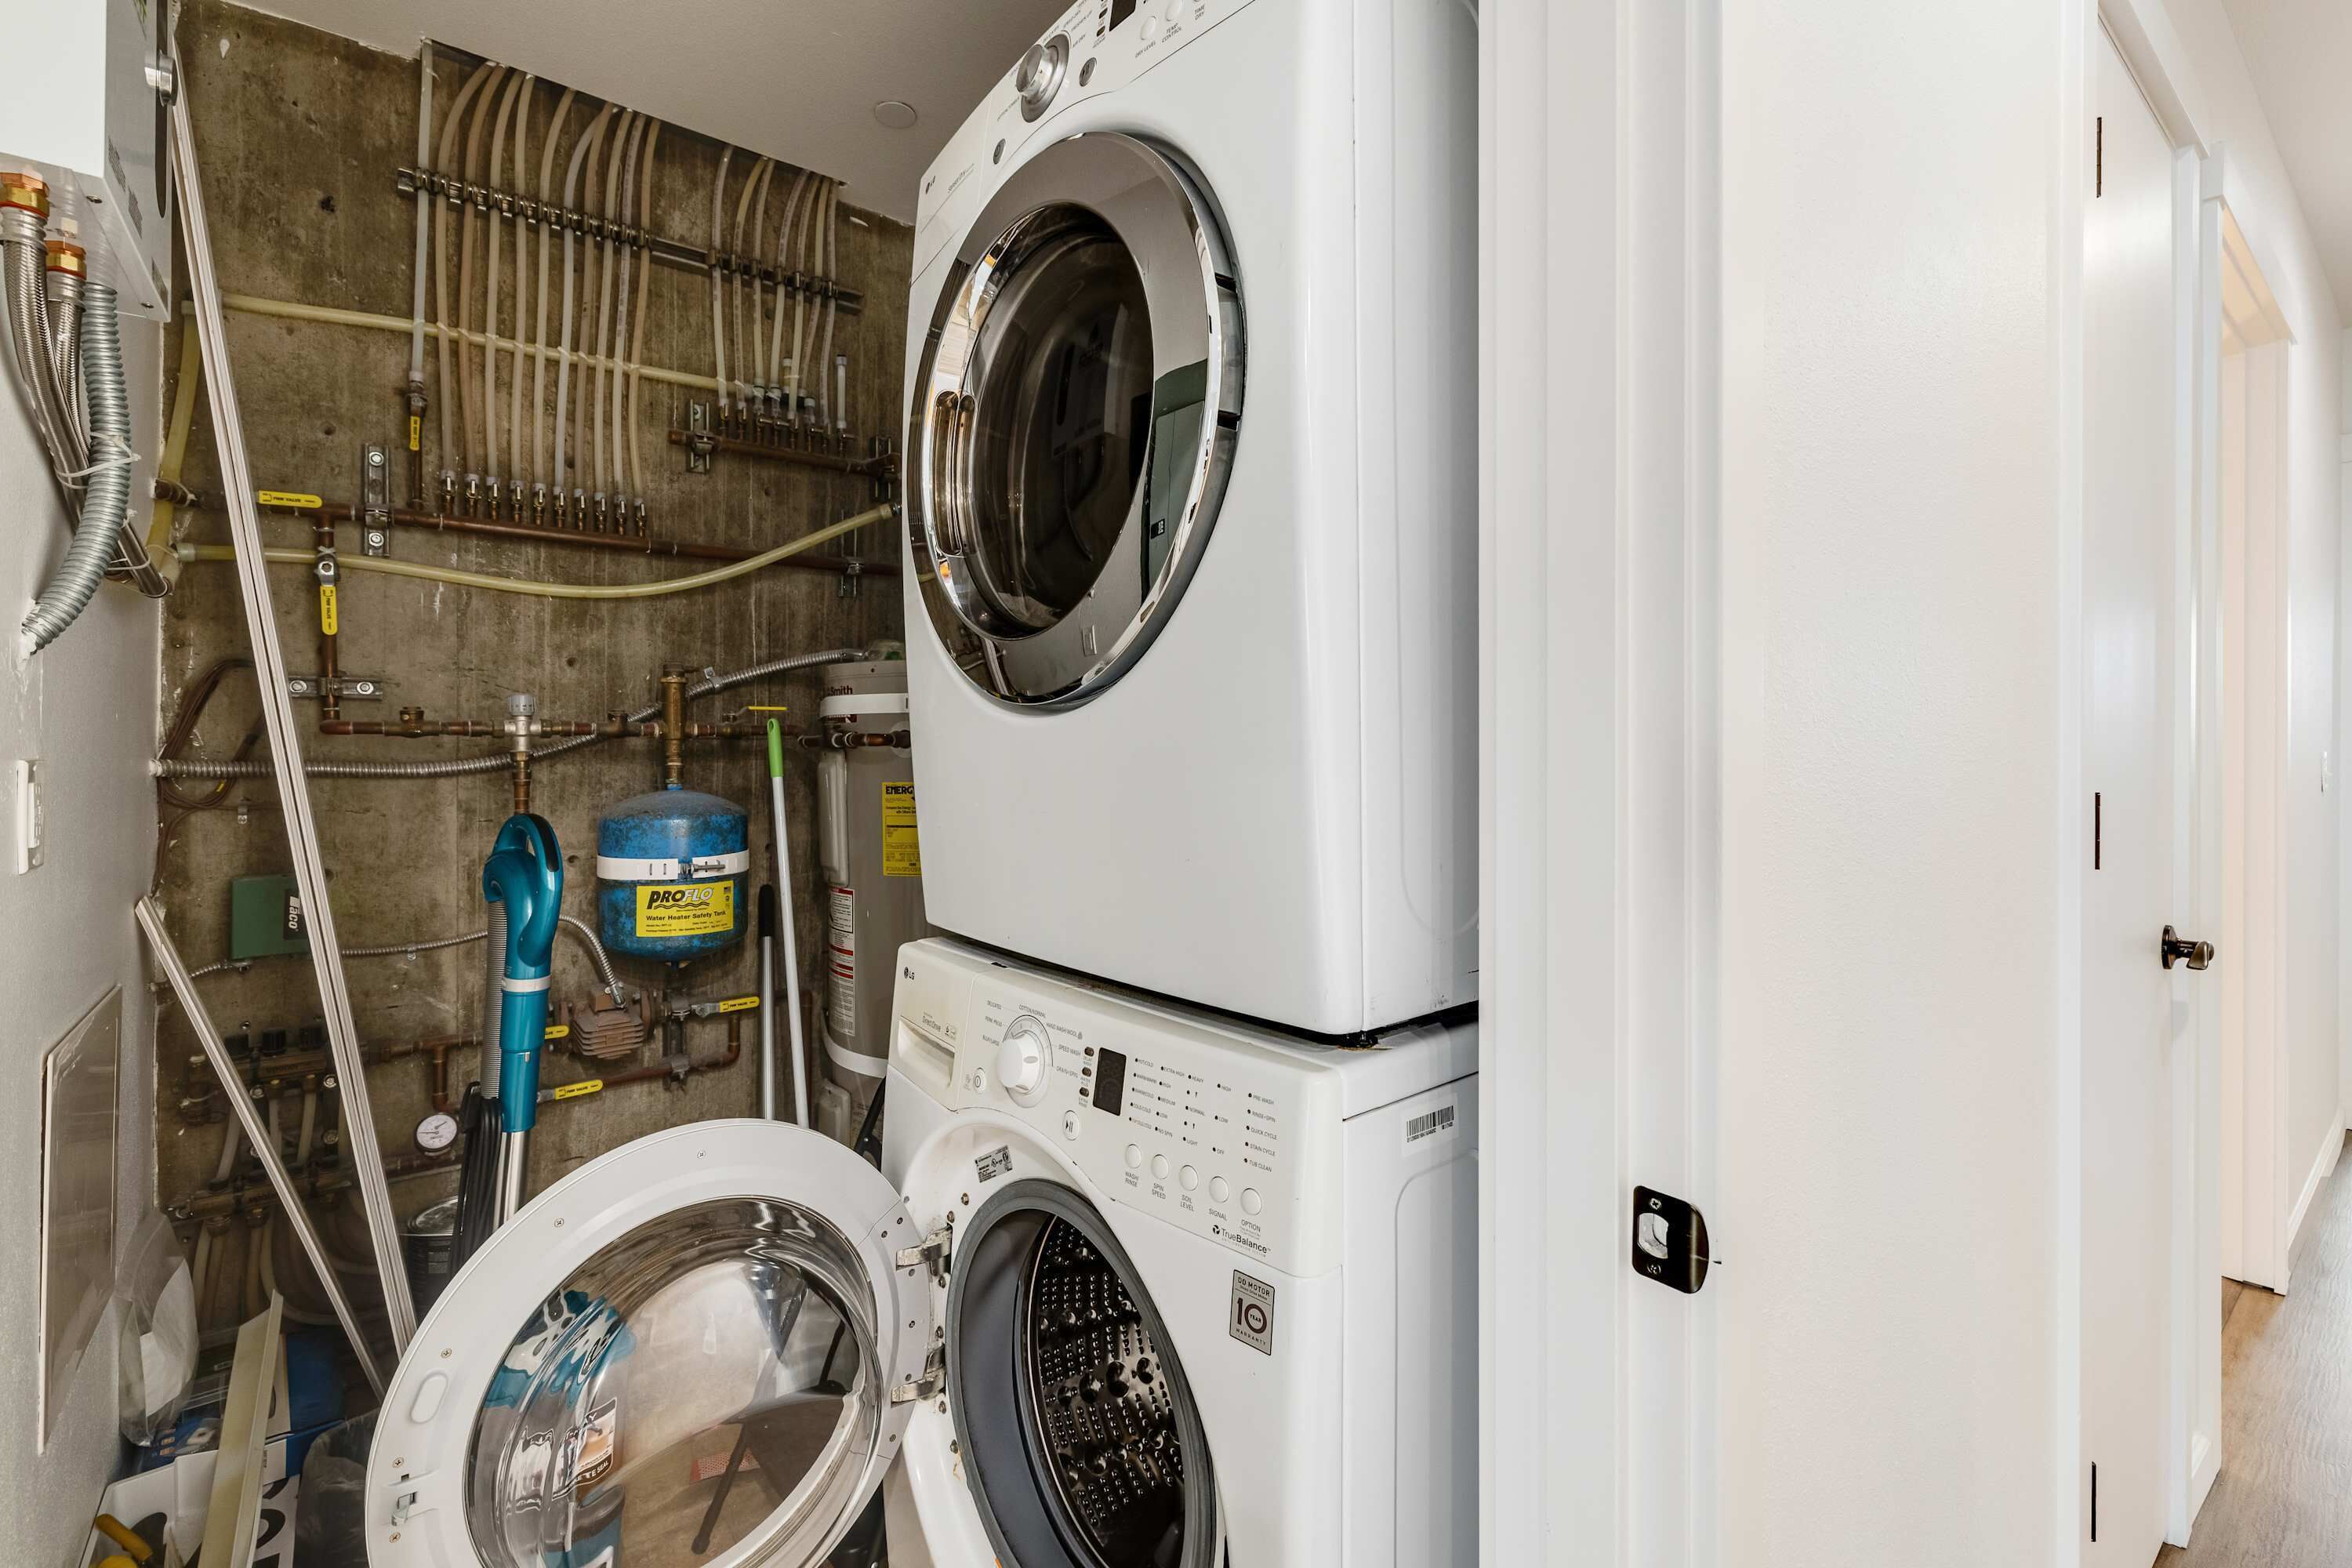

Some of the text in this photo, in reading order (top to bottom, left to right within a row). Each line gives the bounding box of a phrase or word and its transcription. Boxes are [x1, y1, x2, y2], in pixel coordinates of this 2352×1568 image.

[1144, 40, 1156, 53] LEVEL
[647, 887, 714, 909] PROFLO
[1250, 1127, 1279, 1141] QUICK CYCLE
[1250, 1142, 1276, 1156] STAIN CYCLE
[1258, 1162, 1272, 1172] CLEAN
[1124, 1178, 1138, 1188] RINSE
[1152, 1182, 1164, 1192] SPIN
[1151, 1189, 1167, 1200] SPEED
[1181, 1194, 1192, 1204] SOIL
[1180, 1200, 1195, 1212] LEVEL
[1208, 1207, 1228, 1221] SIGNAL
[1241, 1218, 1261, 1233] OPTION
[1221, 1228, 1268, 1254] TrueBalance
[1238, 1276, 1270, 1298] DD MOTOR
[1236, 1297, 1268, 1334] 10
[1249, 1313, 1261, 1323] YEAR
[1236, 1327, 1266, 1346] WARRANTY
[597, 1460, 610, 1472] SEAL
